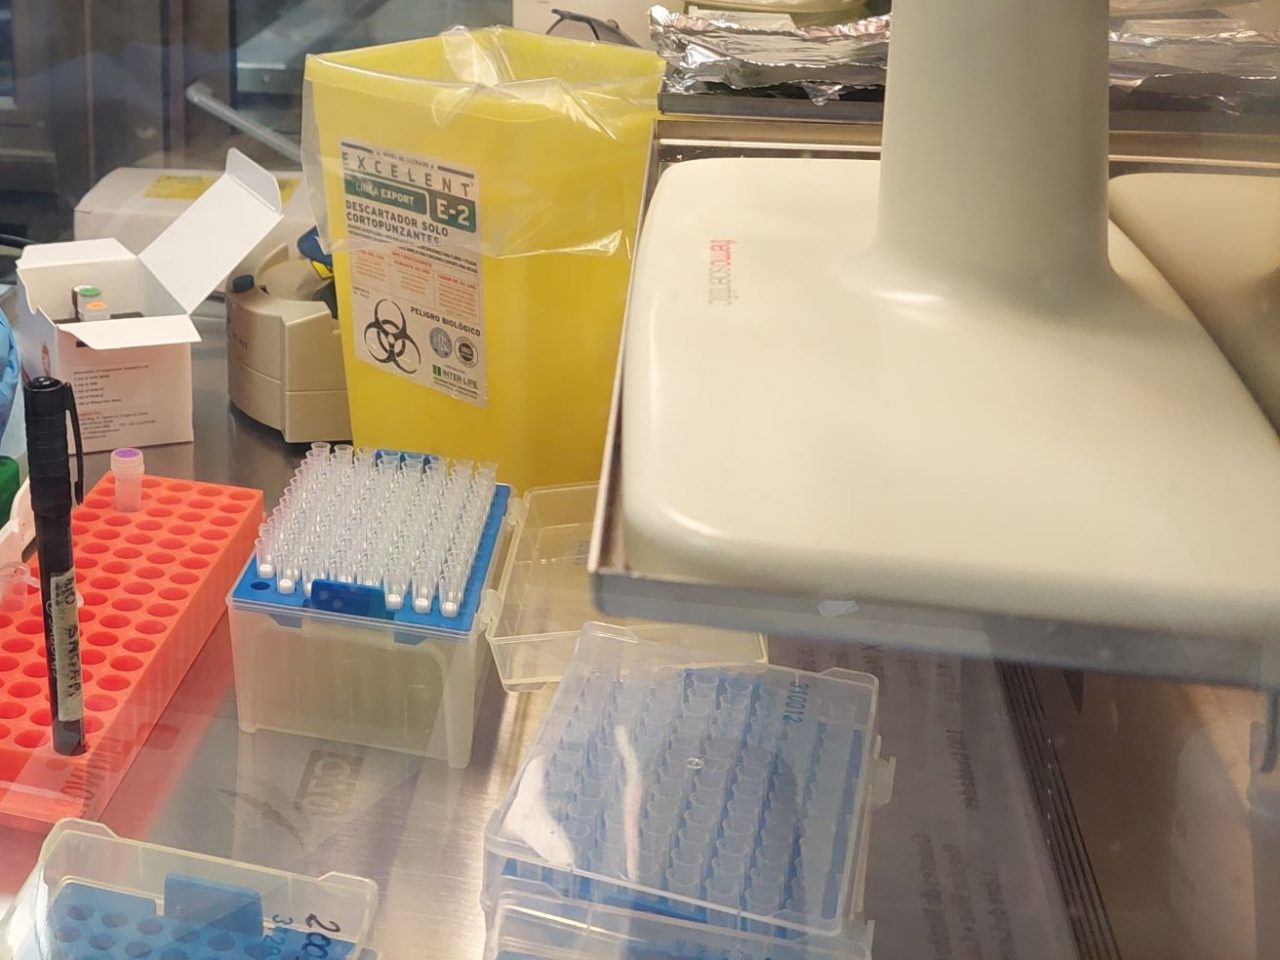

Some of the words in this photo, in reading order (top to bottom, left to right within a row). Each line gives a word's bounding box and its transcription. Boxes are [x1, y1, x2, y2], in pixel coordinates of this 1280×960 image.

[341, 152, 470, 197] EXCELENT
[380, 188, 415, 206] EXPORT
[436, 198, 470, 226] E-2
[345, 200, 418, 228] DESCARTADOR
[421, 221, 449, 238] SOLO
[346, 212, 441, 244] CORTOPUNZANTES
[410, 305, 440, 322] PELIGRO
[441, 317, 481, 337] BIOLÓGICO
